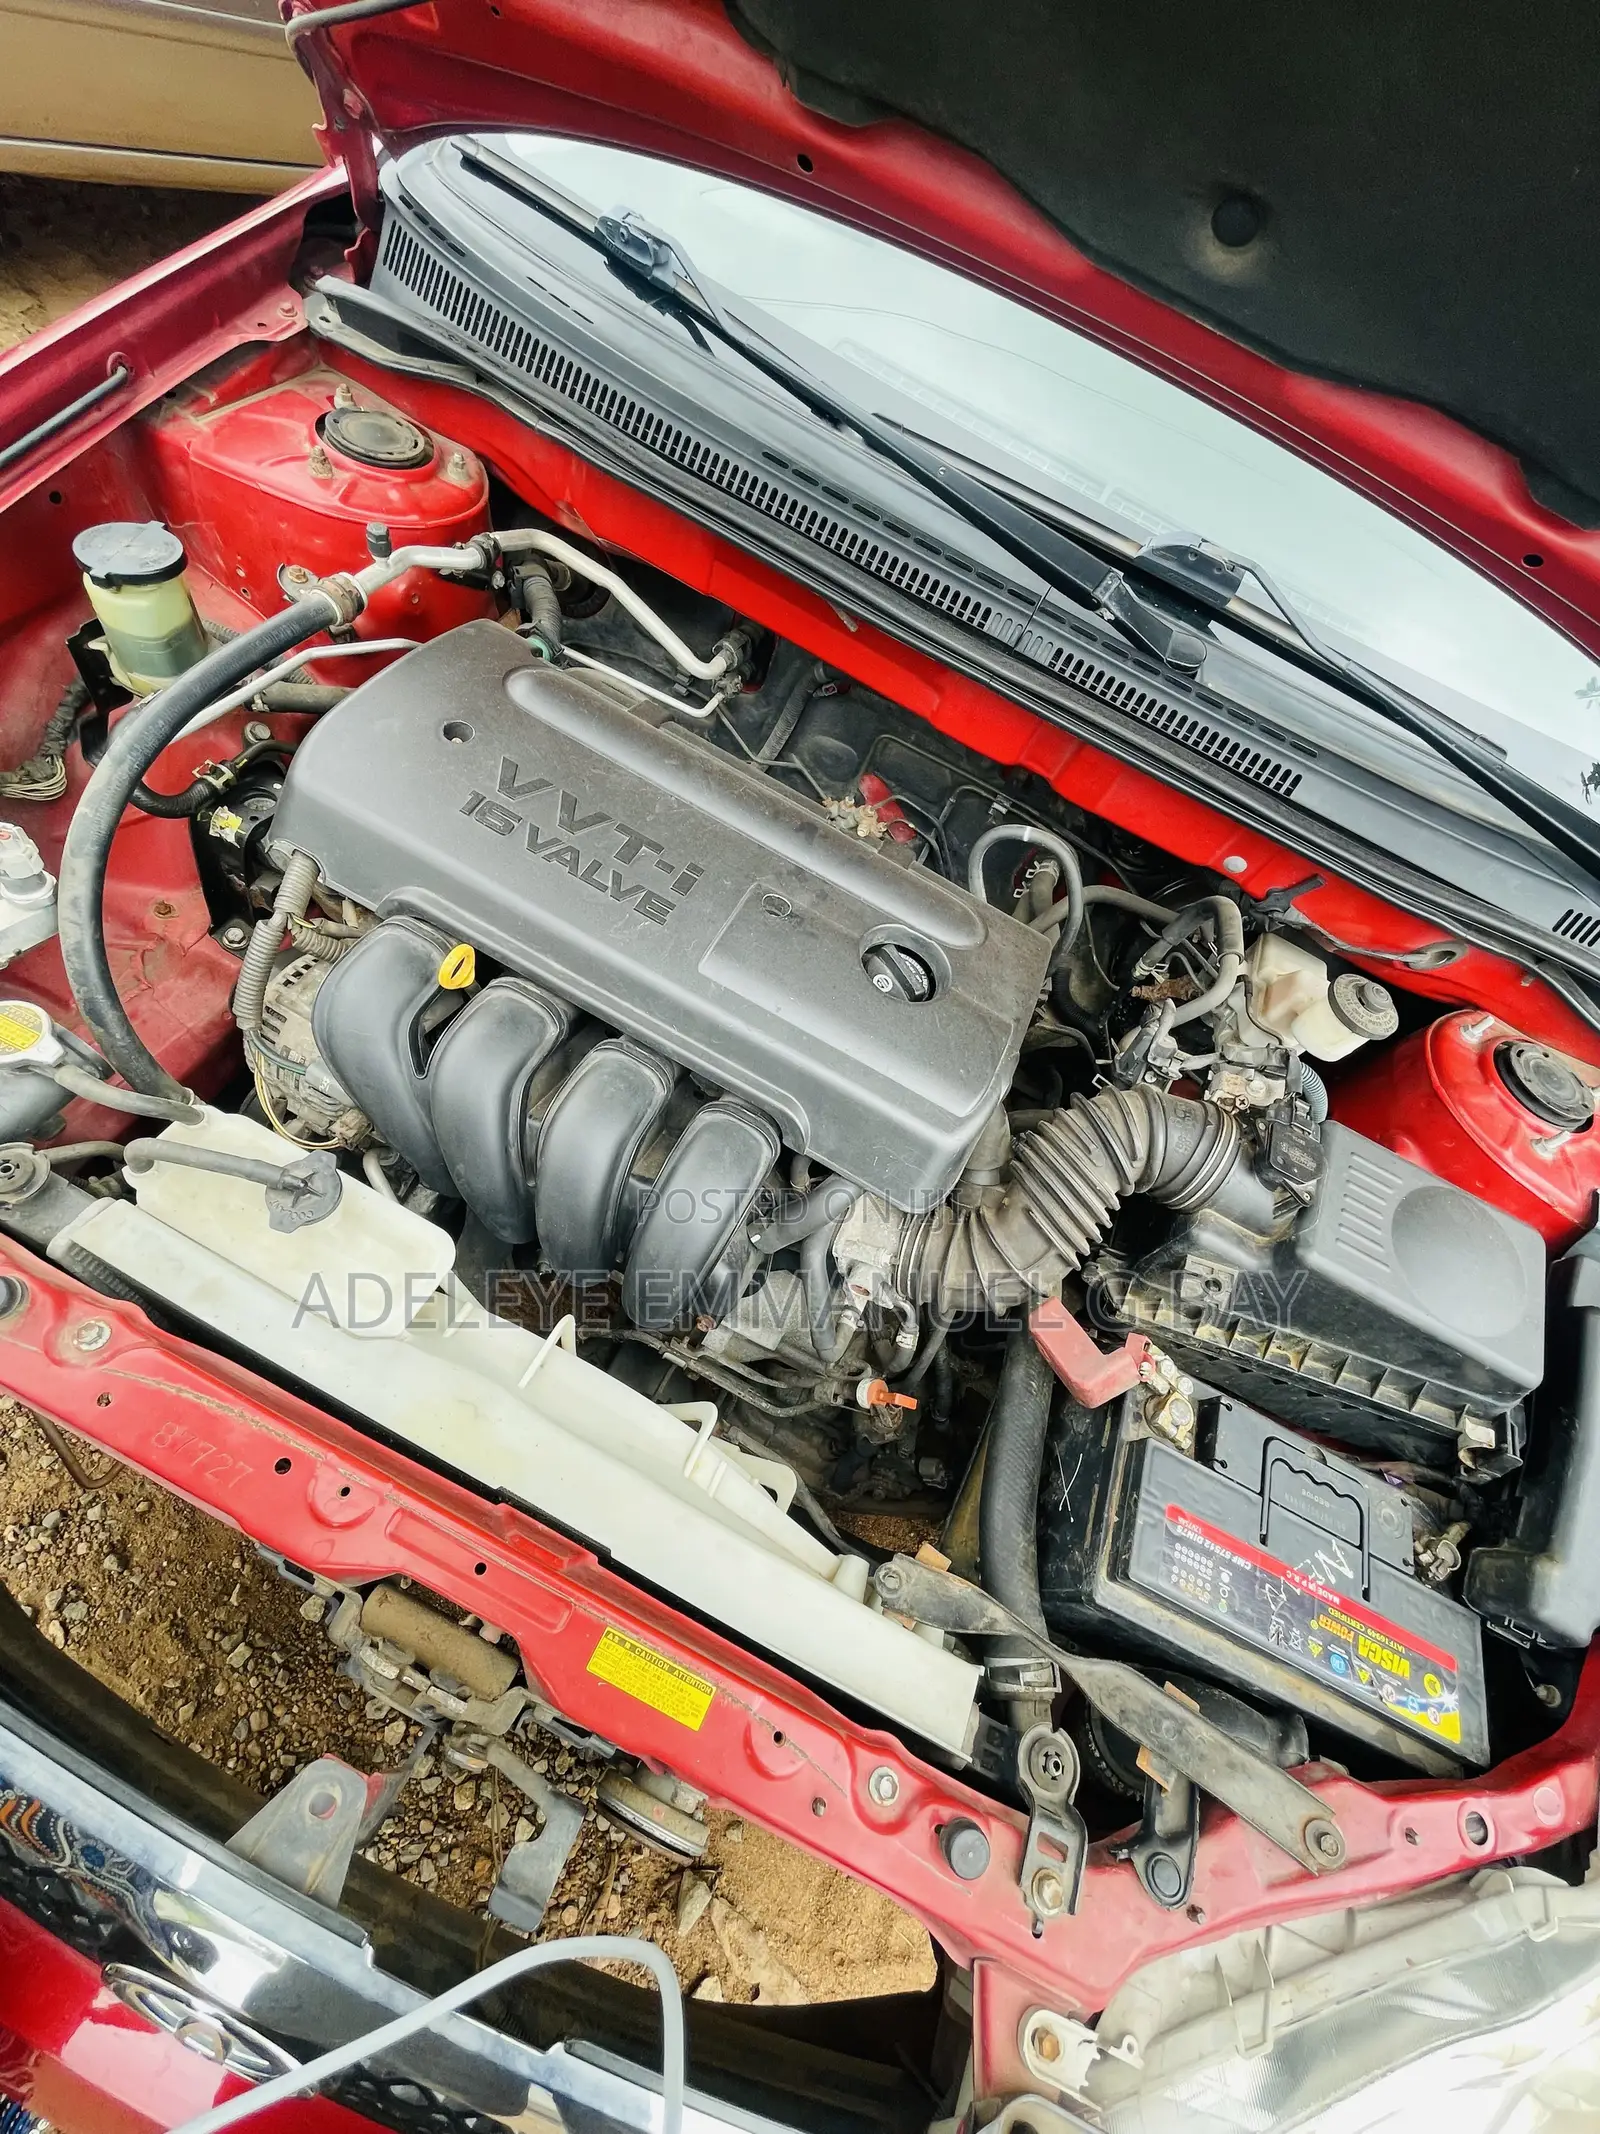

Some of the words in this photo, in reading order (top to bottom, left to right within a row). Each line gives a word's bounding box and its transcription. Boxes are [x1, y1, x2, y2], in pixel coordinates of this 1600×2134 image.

[496, 755, 705, 897] VVT-i
[458, 788, 523, 836] 16
[525, 822, 677, 926] VALVE
[1175, 1524, 1204, 1545] DIN75
[1317, 1586, 1340, 1605] MADE
[1318, 1613, 1355, 1643] POWER
[1327, 1606, 1366, 1632] CERTIFIED
[634, 1646, 670, 1670] CAUTION
[673, 1670, 712, 1695] ATTENTION
[1357, 1634, 1410, 1681] VISCA
